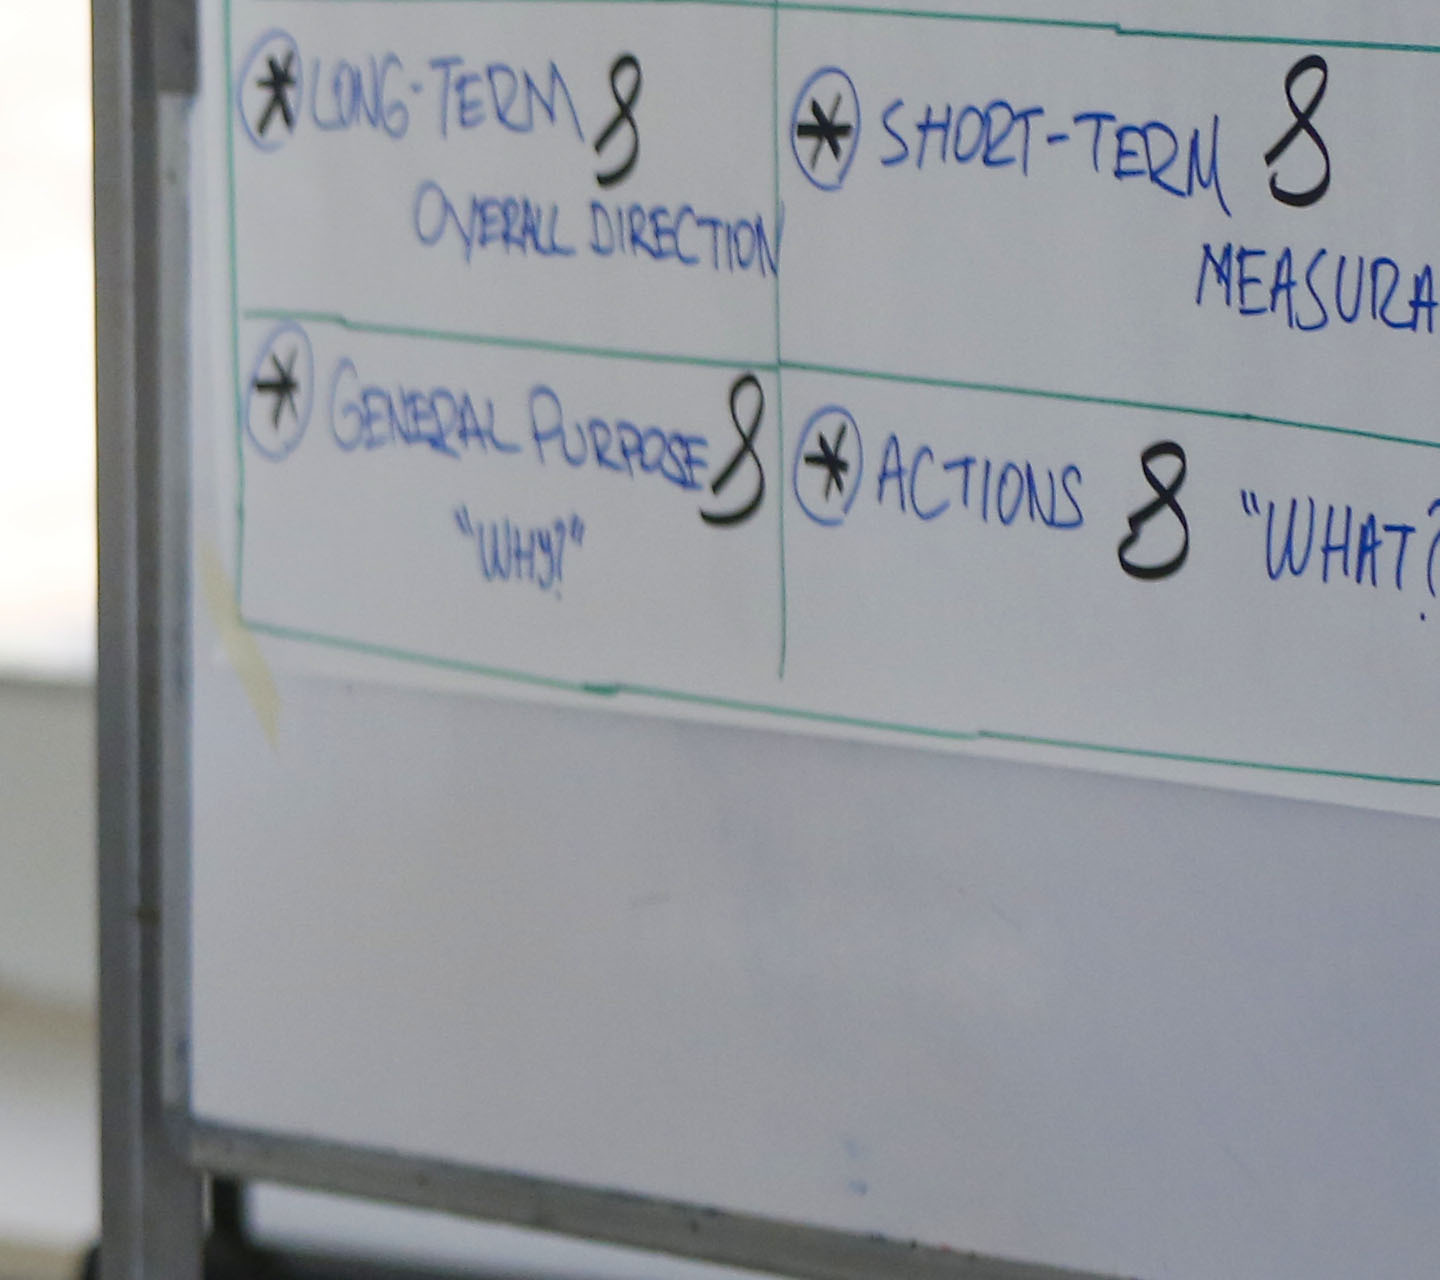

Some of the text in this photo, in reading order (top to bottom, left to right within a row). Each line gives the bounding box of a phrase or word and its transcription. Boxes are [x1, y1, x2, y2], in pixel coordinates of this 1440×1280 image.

[880, 99, 1232, 217] SHORT-TERM
[413, 180, 786, 278] OVERALL DIRECTION
[329, 357, 522, 460] GENERAL
[528, 384, 710, 492] PURPOSE
[877, 432, 1084, 530] ACTIONS
